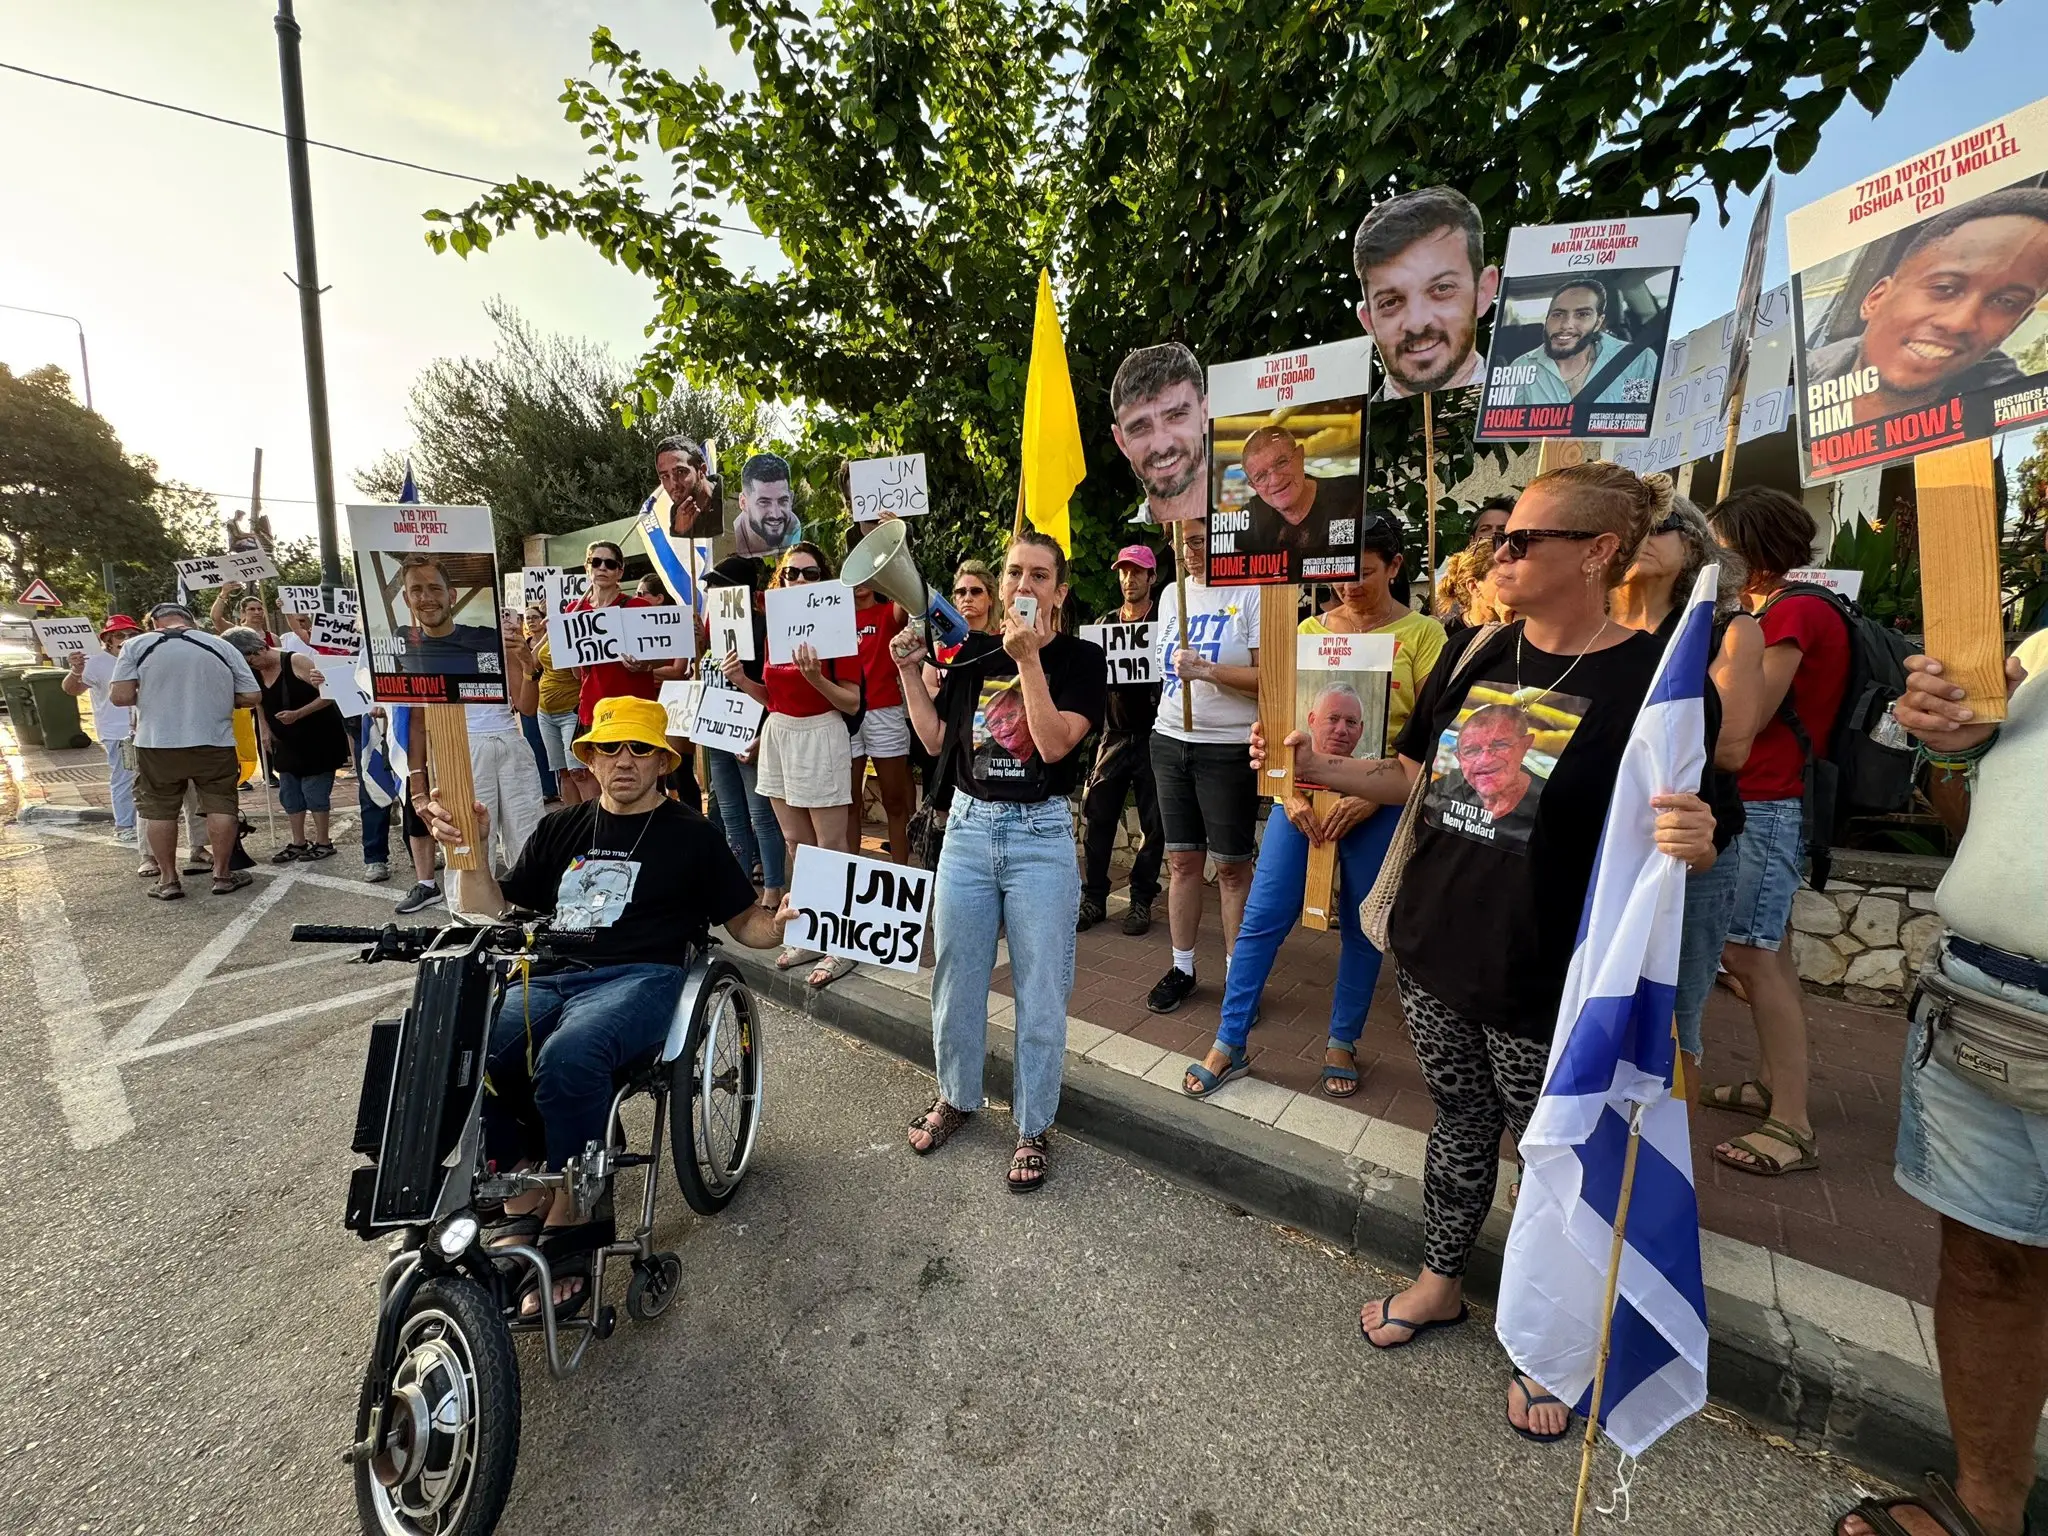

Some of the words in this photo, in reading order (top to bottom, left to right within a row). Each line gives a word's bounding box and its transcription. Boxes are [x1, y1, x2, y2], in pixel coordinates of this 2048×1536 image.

[1895, 149, 1946, 185] לואיטו
[1848, 187, 1904, 225] JOSHUA
[1907, 165, 1951, 198] LOITU
[1956, 137, 2021, 178] MOLLEL
[1856, 174, 1891, 202] מולל
[1915, 186, 1945, 214] (21)
[1568, 224, 1607, 240] צנגאוקר
[1608, 223, 1626, 236] מתן
[1551, 240, 1582, 255] MATAN
[1584, 236, 1638, 251] ZANGAUKER
[1568, 253, 1594, 267] (25)
[1264, 356, 1293, 374] גודארד
[1294, 353, 1308, 368] מני
[1257, 375, 1279, 390] MENY
[1281, 367, 1315, 386] GODARD
[1490, 364, 1537, 386] BRING
[1277, 386, 1293, 402] (73)
[1487, 387, 1516, 406] HIM
[1807, 366, 1880, 411] BRING
[1993, 388, 2041, 409] HOSTAGES
[1484, 408, 1524, 428] HOME
[1588, 420, 1620, 430] FAMILIES
[1620, 420, 1646, 430] FORUM
[1809, 400, 1853, 438] HIM
[1810, 424, 1878, 467] HOME
[881, 458, 916, 485] מני
[853, 485, 927, 515] גודארד
[400, 509, 415, 522] פרץ
[416, 510, 437, 522] דניאל
[1211, 509, 1250, 534] BRING
[393, 522, 419, 533] DANIEL
[421, 522, 448, 534] PERETZ
[414, 535, 430, 547] (22)
[1211, 533, 1235, 554] HIM
[240, 565, 265, 578] הימן
[1210, 555, 1246, 577] HOME
[1303, 563, 1331, 575] FAMILIES
[1331, 563, 1355, 574] FORUM
[201, 573, 223, 584] אור
[294, 600, 320, 614] כהן
[806, 593, 841, 608] אריאל
[641, 612, 680, 625] עמרי
[42, 624, 92, 637] פונגסאק
[563, 610, 608, 649] אלון
[787, 623, 815, 637] קוניו
[57, 640, 84, 650] טנה
[321, 632, 360, 648] David
[371, 636, 406, 655] BRING
[637, 635, 672, 652] מירן
[1102, 624, 1149, 657] איתן
[1323, 637, 1334, 646] וייס
[1336, 637, 1348, 647] אילן
[1318, 647, 1332, 655] ILAN
[1333, 647, 1352, 656] WEISS
[373, 655, 396, 673] HIM
[1328, 656, 1341, 666] (56)
[375, 676, 408, 694] HOME
[459, 688, 483, 698] FAMILIES
[484, 689, 503, 698] FORUM
[726, 699, 744, 715] בר
[696, 716, 755, 743] קופרשטיין
[988, 767, 1003, 777] Meny
[1004, 767, 1025, 777] Godard
[1450, 800, 1478, 820] גודארד
[1480, 809, 1493, 824] מני
[1442, 811, 1463, 831] Meny
[1465, 819, 1495, 840] Godard
[842, 862, 926, 917] מתן
[798, 908, 922, 964] צנגאוקר
